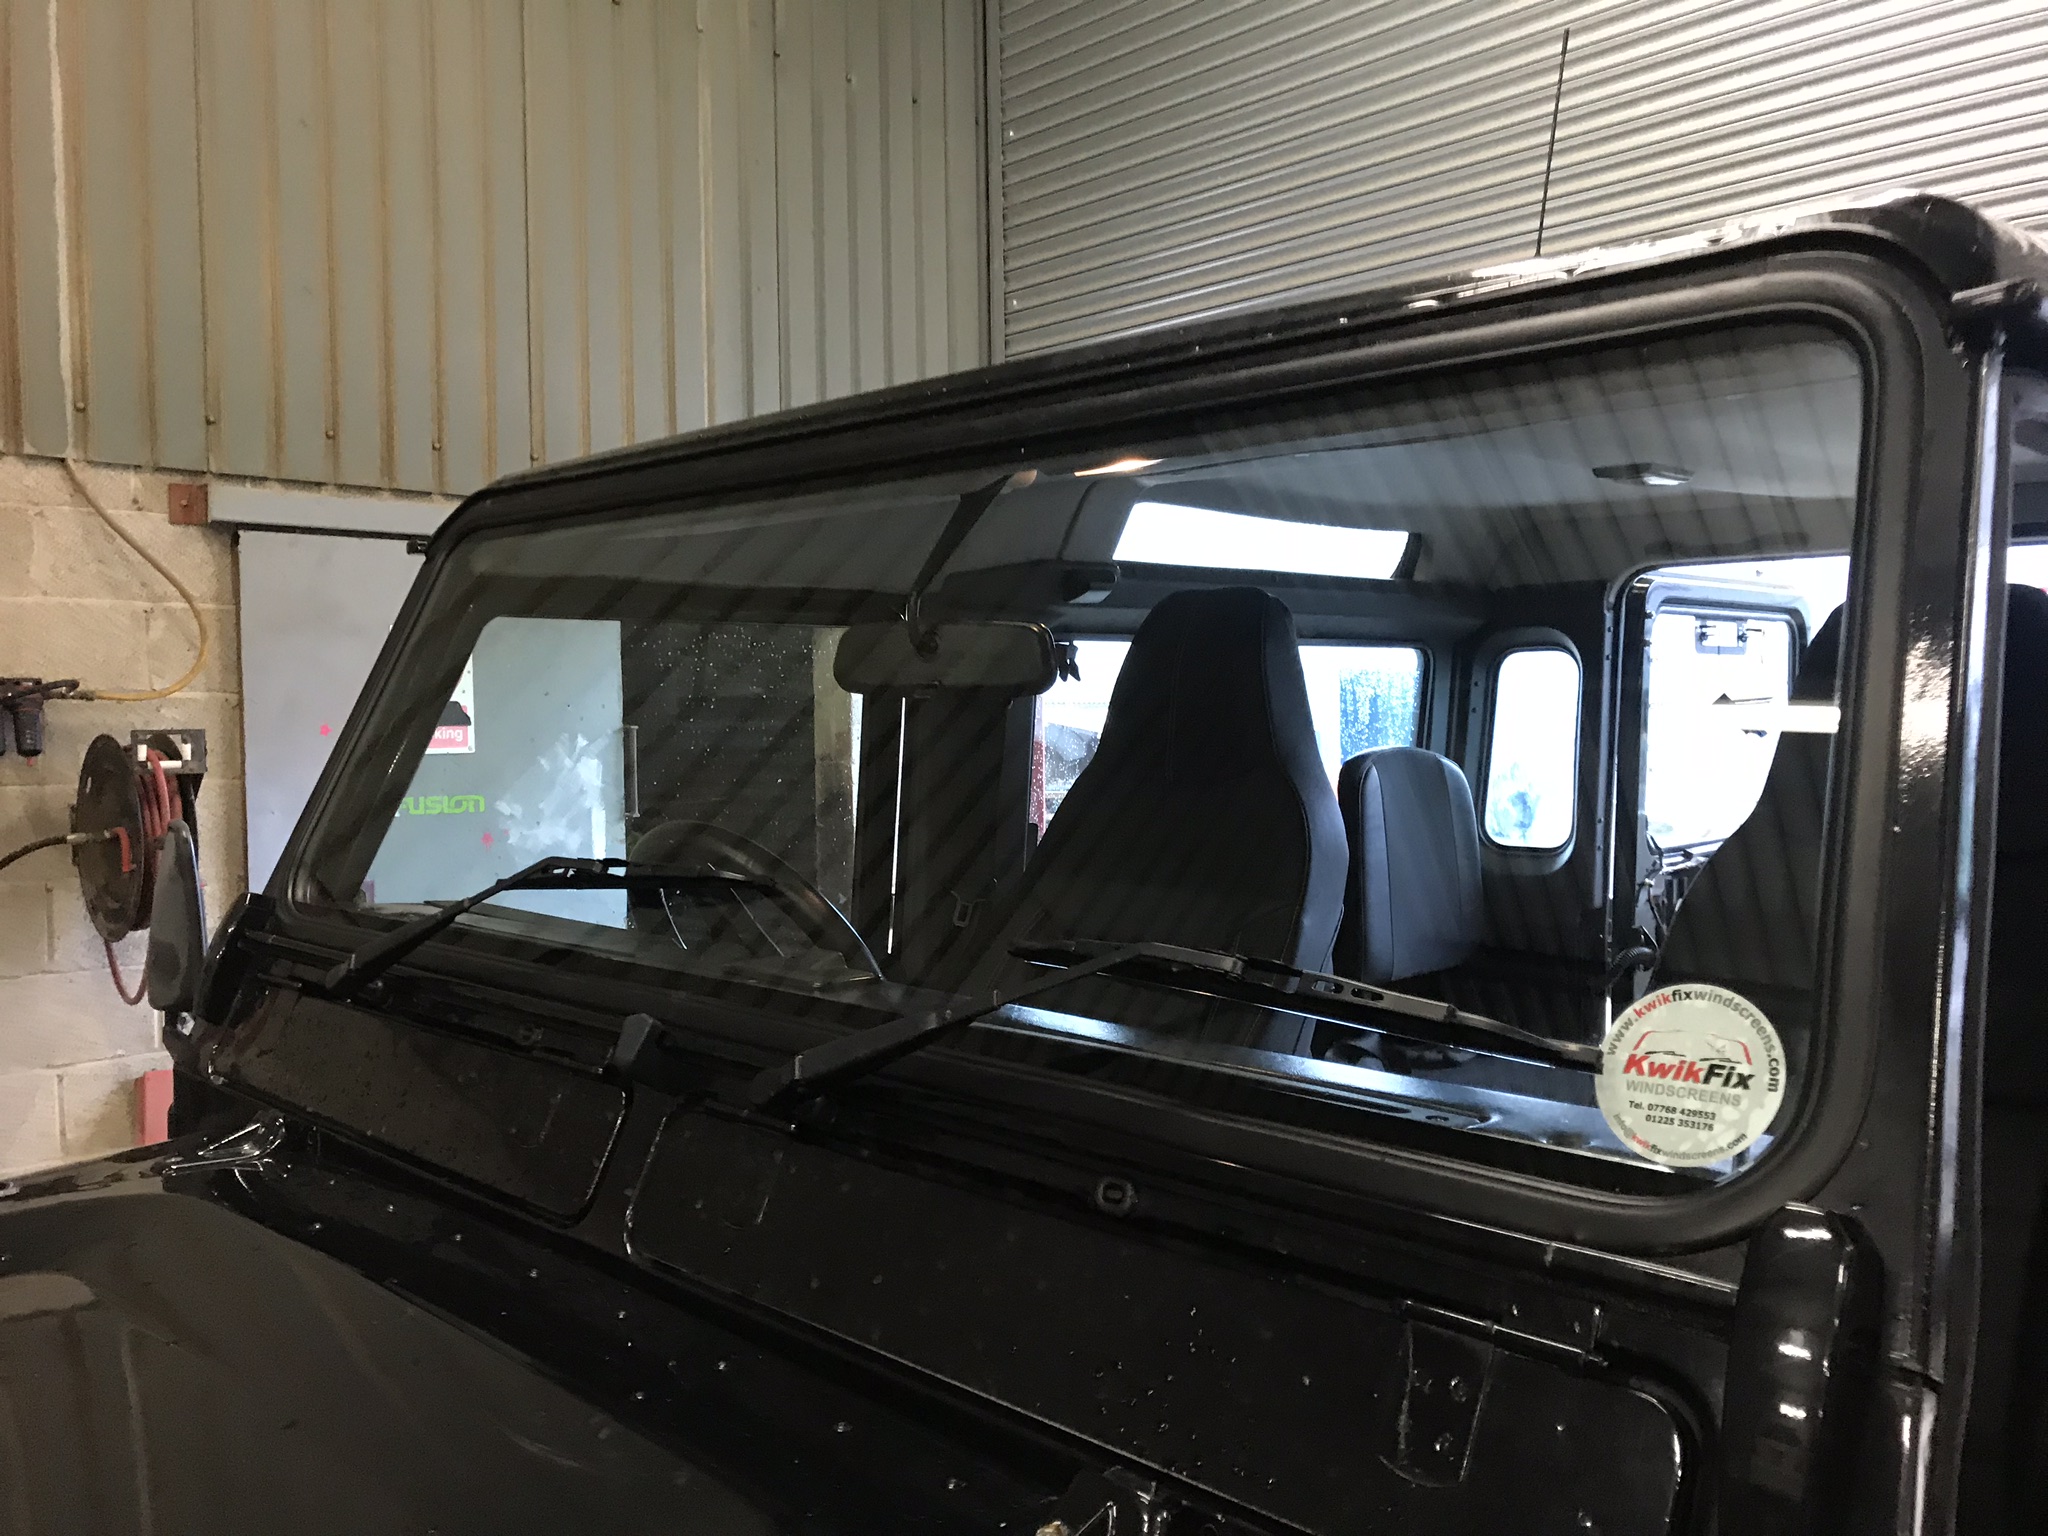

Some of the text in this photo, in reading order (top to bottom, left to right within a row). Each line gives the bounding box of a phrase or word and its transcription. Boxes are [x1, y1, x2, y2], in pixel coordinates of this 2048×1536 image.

[434, 727, 463, 742] king
[1607, 989, 1780, 1093] www.kwikfixwindscreens.com
[1622, 1054, 1755, 1090] KwikFix
[1626, 1080, 1742, 1107] WINDSCREENS
[1629, 1100, 1717, 1121] Tel. 07768 429553
[1645, 1114, 1675, 1126] 01225
